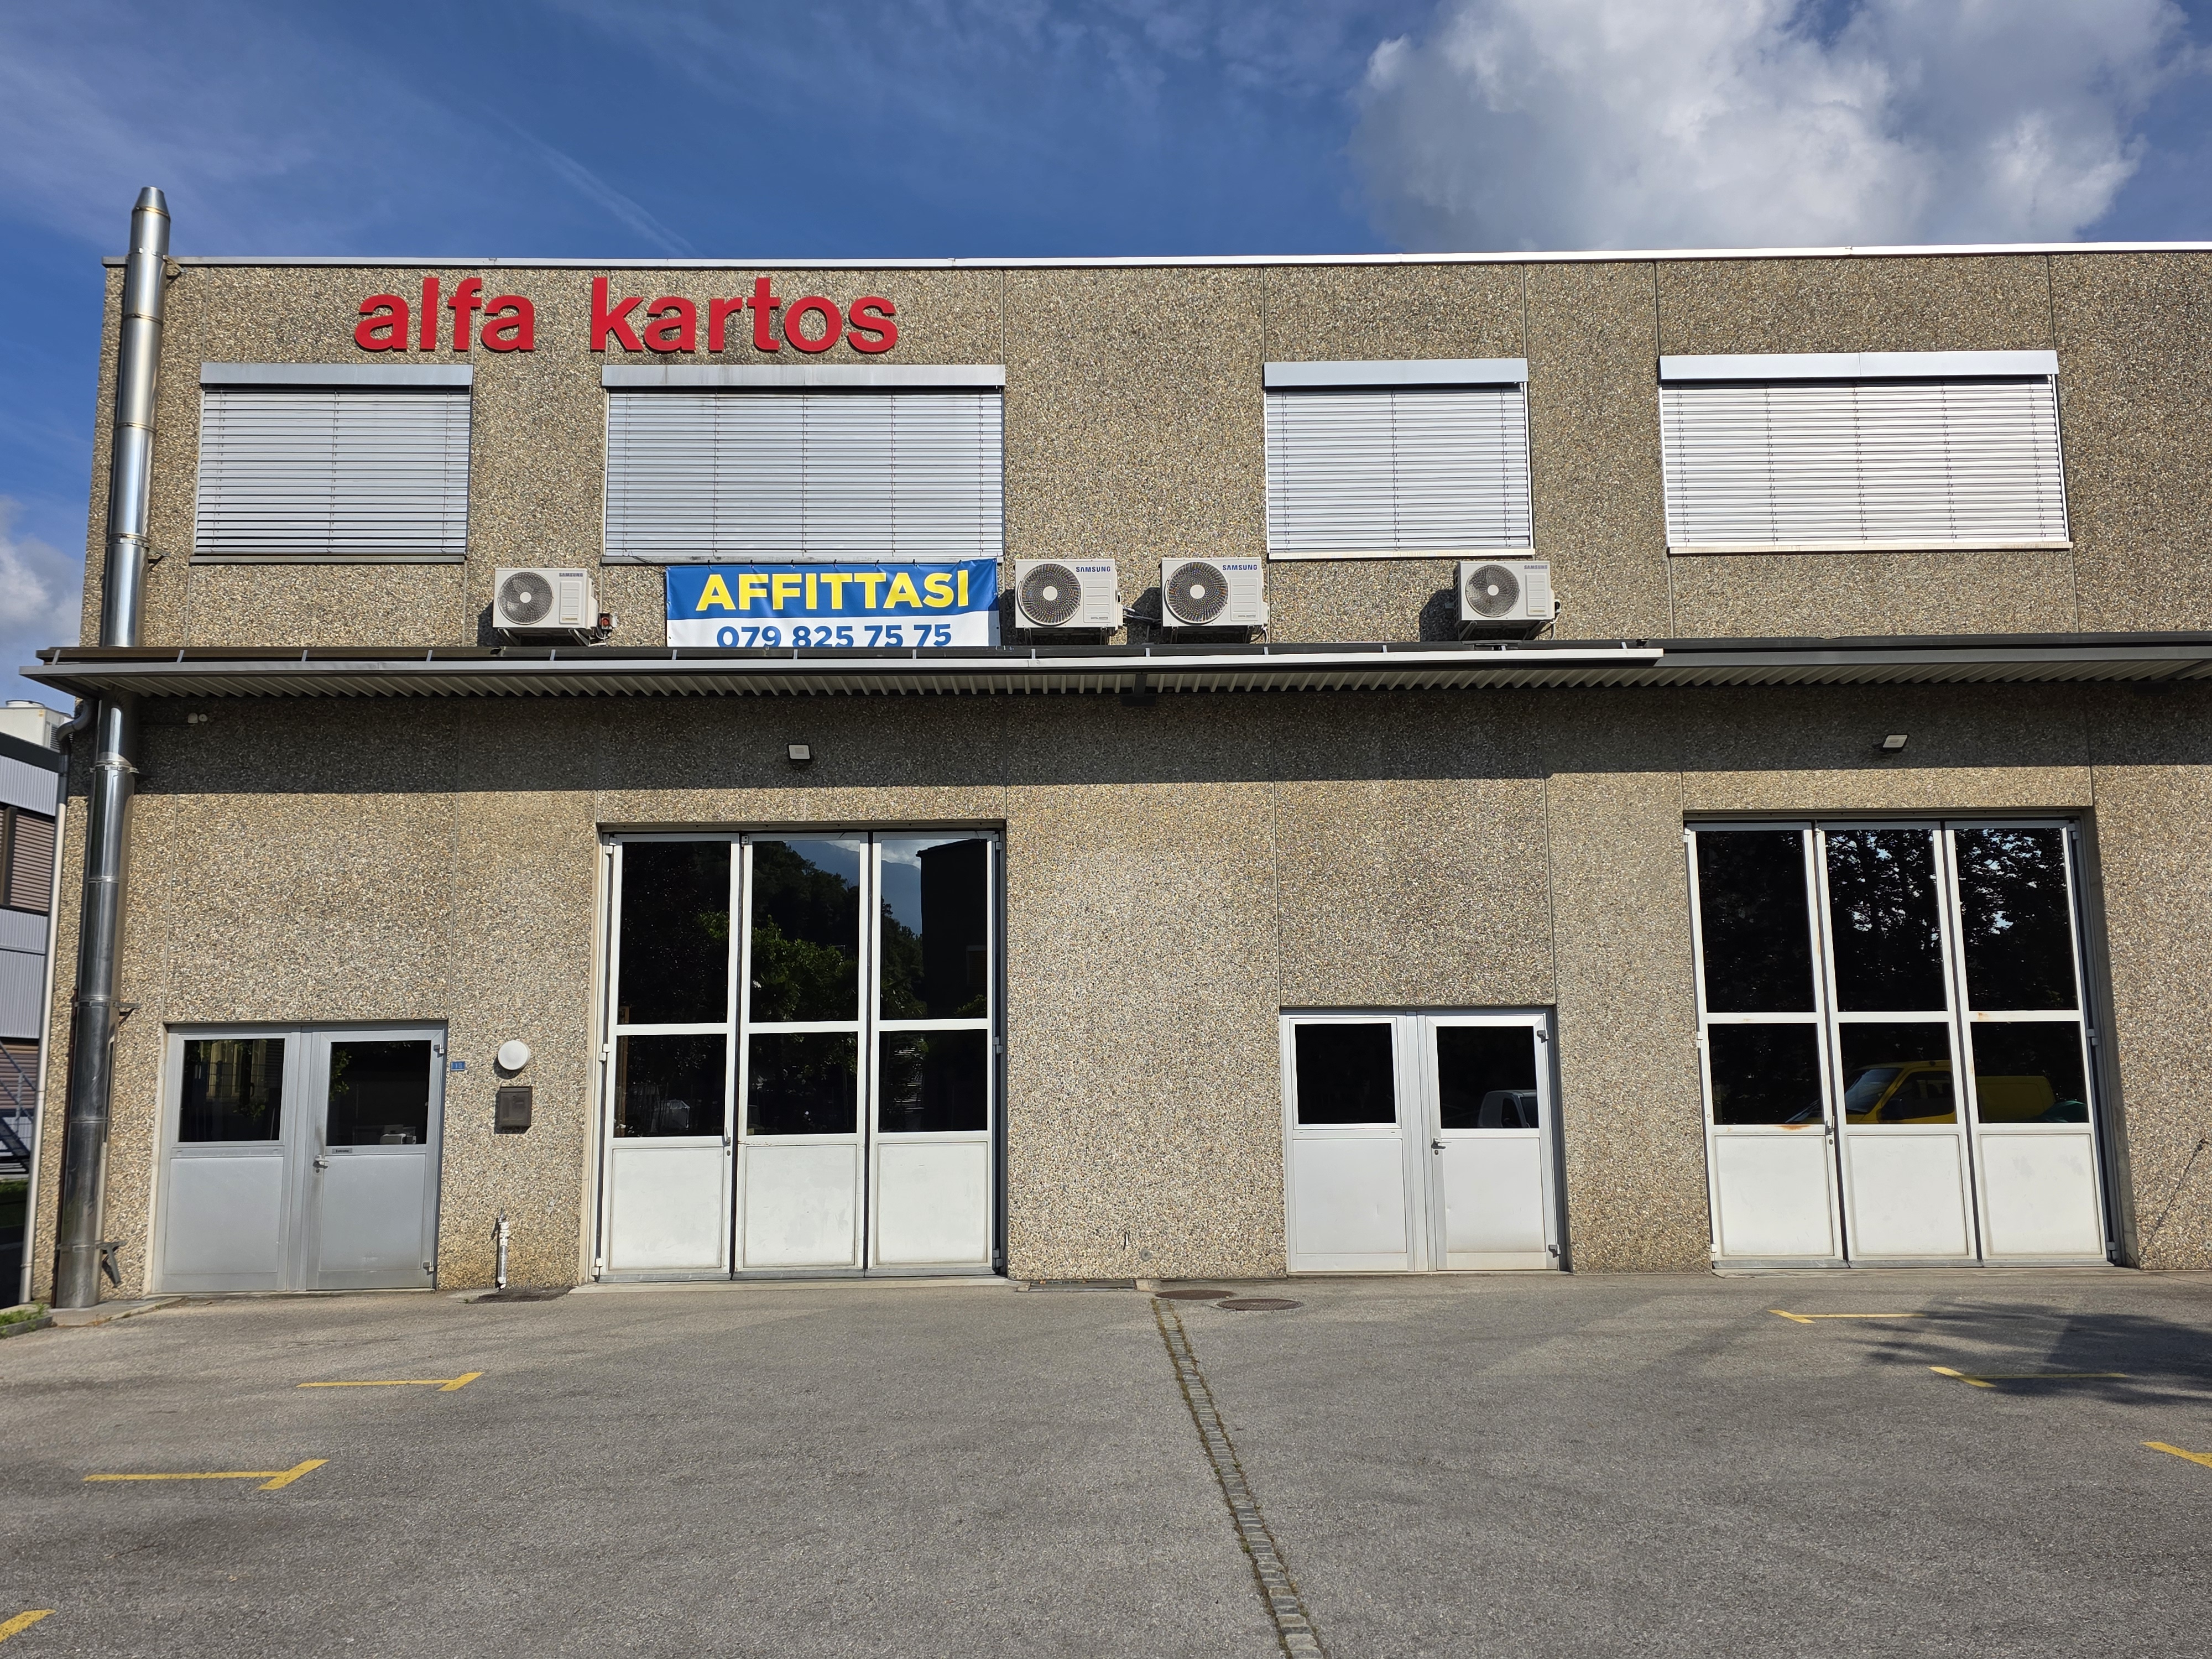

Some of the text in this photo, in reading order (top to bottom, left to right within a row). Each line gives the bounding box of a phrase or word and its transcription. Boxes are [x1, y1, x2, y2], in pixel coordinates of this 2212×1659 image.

[354, 276, 898, 353] alfa kartos
[696, 570, 968, 611] AFFITTASI
[717, 624, 951, 646] 079 825 75 75
